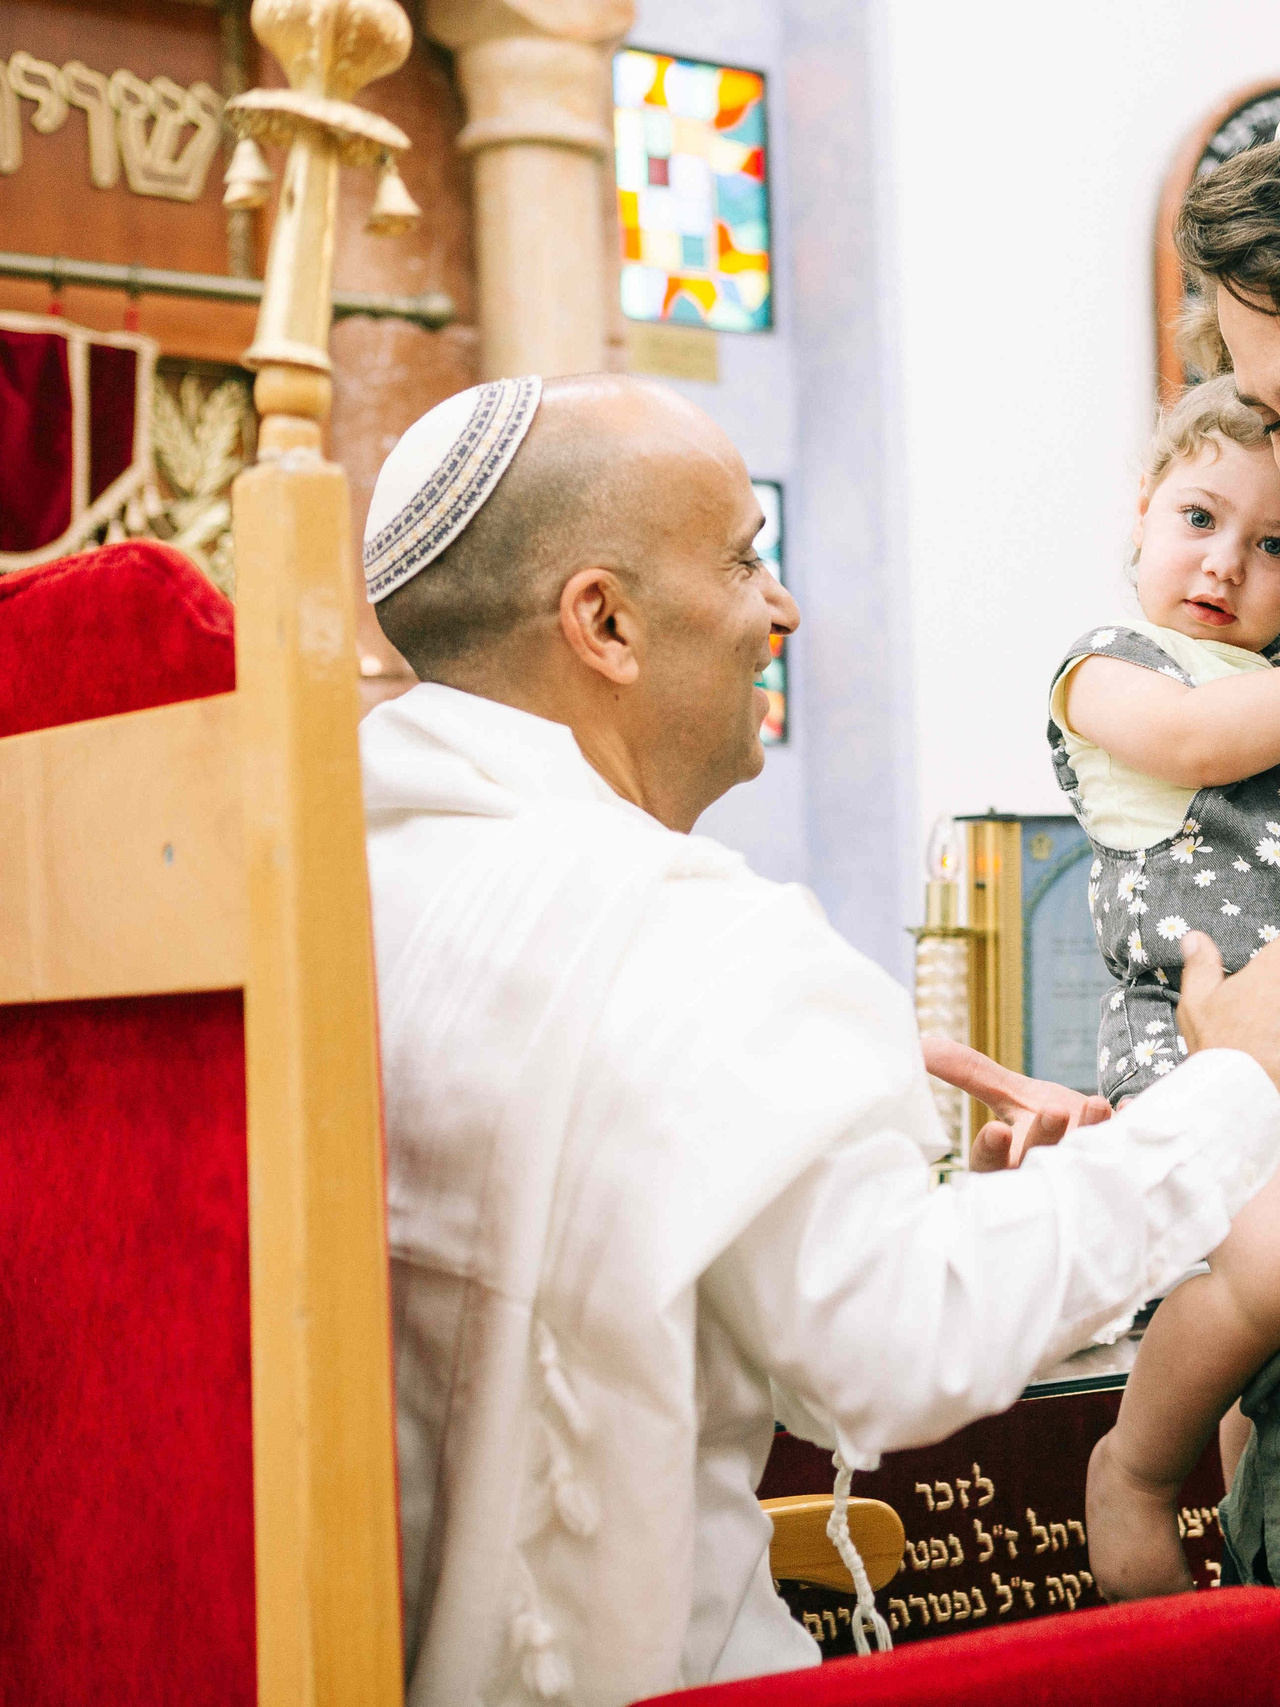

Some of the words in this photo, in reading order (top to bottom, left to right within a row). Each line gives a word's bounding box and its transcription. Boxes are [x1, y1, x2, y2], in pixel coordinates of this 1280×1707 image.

[915, 1462, 995, 1512] לזכר
[1026, 1507, 1086, 1553] רחל
[900, 1533, 964, 1573] נפט
[888, 1586, 988, 1631] נפטרה
[1046, 1570, 1094, 1611] יקה
[802, 1603, 877, 1642] יום
